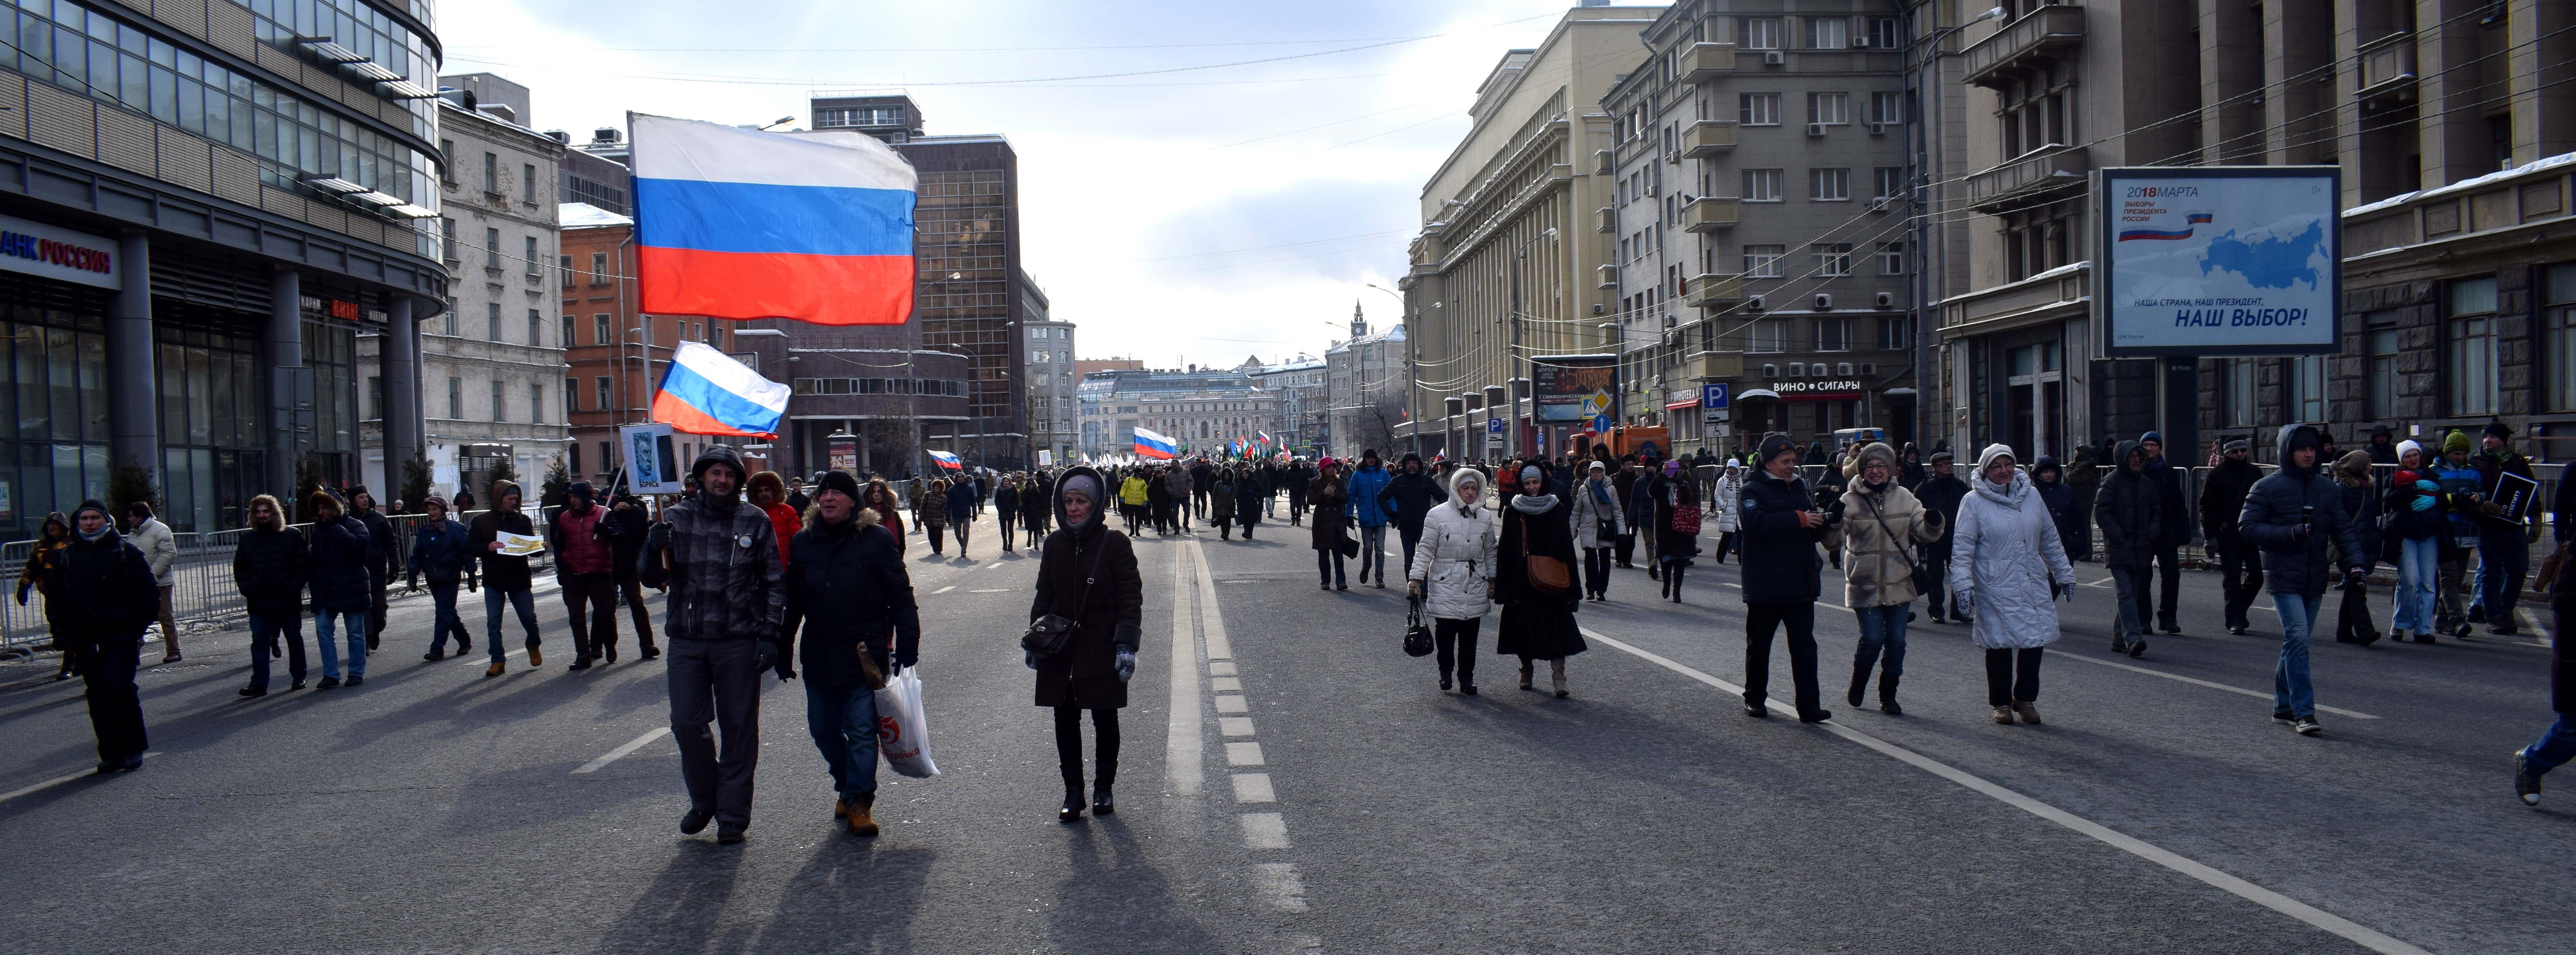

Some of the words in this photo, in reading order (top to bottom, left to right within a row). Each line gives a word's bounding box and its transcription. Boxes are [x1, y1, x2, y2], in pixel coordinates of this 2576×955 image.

[2312, 186, 2321, 194] 0+
[0, 230, 39, 261] АНК
[40, 238, 111, 274] РОССИЯ
[2160, 298, 2193, 307] СТРАНА,
[2215, 298, 2264, 307] ПРЕЗИДЕНТ,
[331, 299, 359, 321] ЮЖАНЕ
[2175, 309, 2224, 327] НАШ
[2231, 308, 2308, 326] ВЫБОР!
[1774, 382, 1806, 392] ВИНО
[1817, 381, 1860, 390] СИГАРЫ
[1674, 389, 1695, 401] ВИНОТЕКА
[1709, 387, 1722, 406] P
[1491, 420, 1499, 431] P
[1539, 435, 1543, 444] P
[2507, 490, 2520, 517] ОТВЕТИТ?
